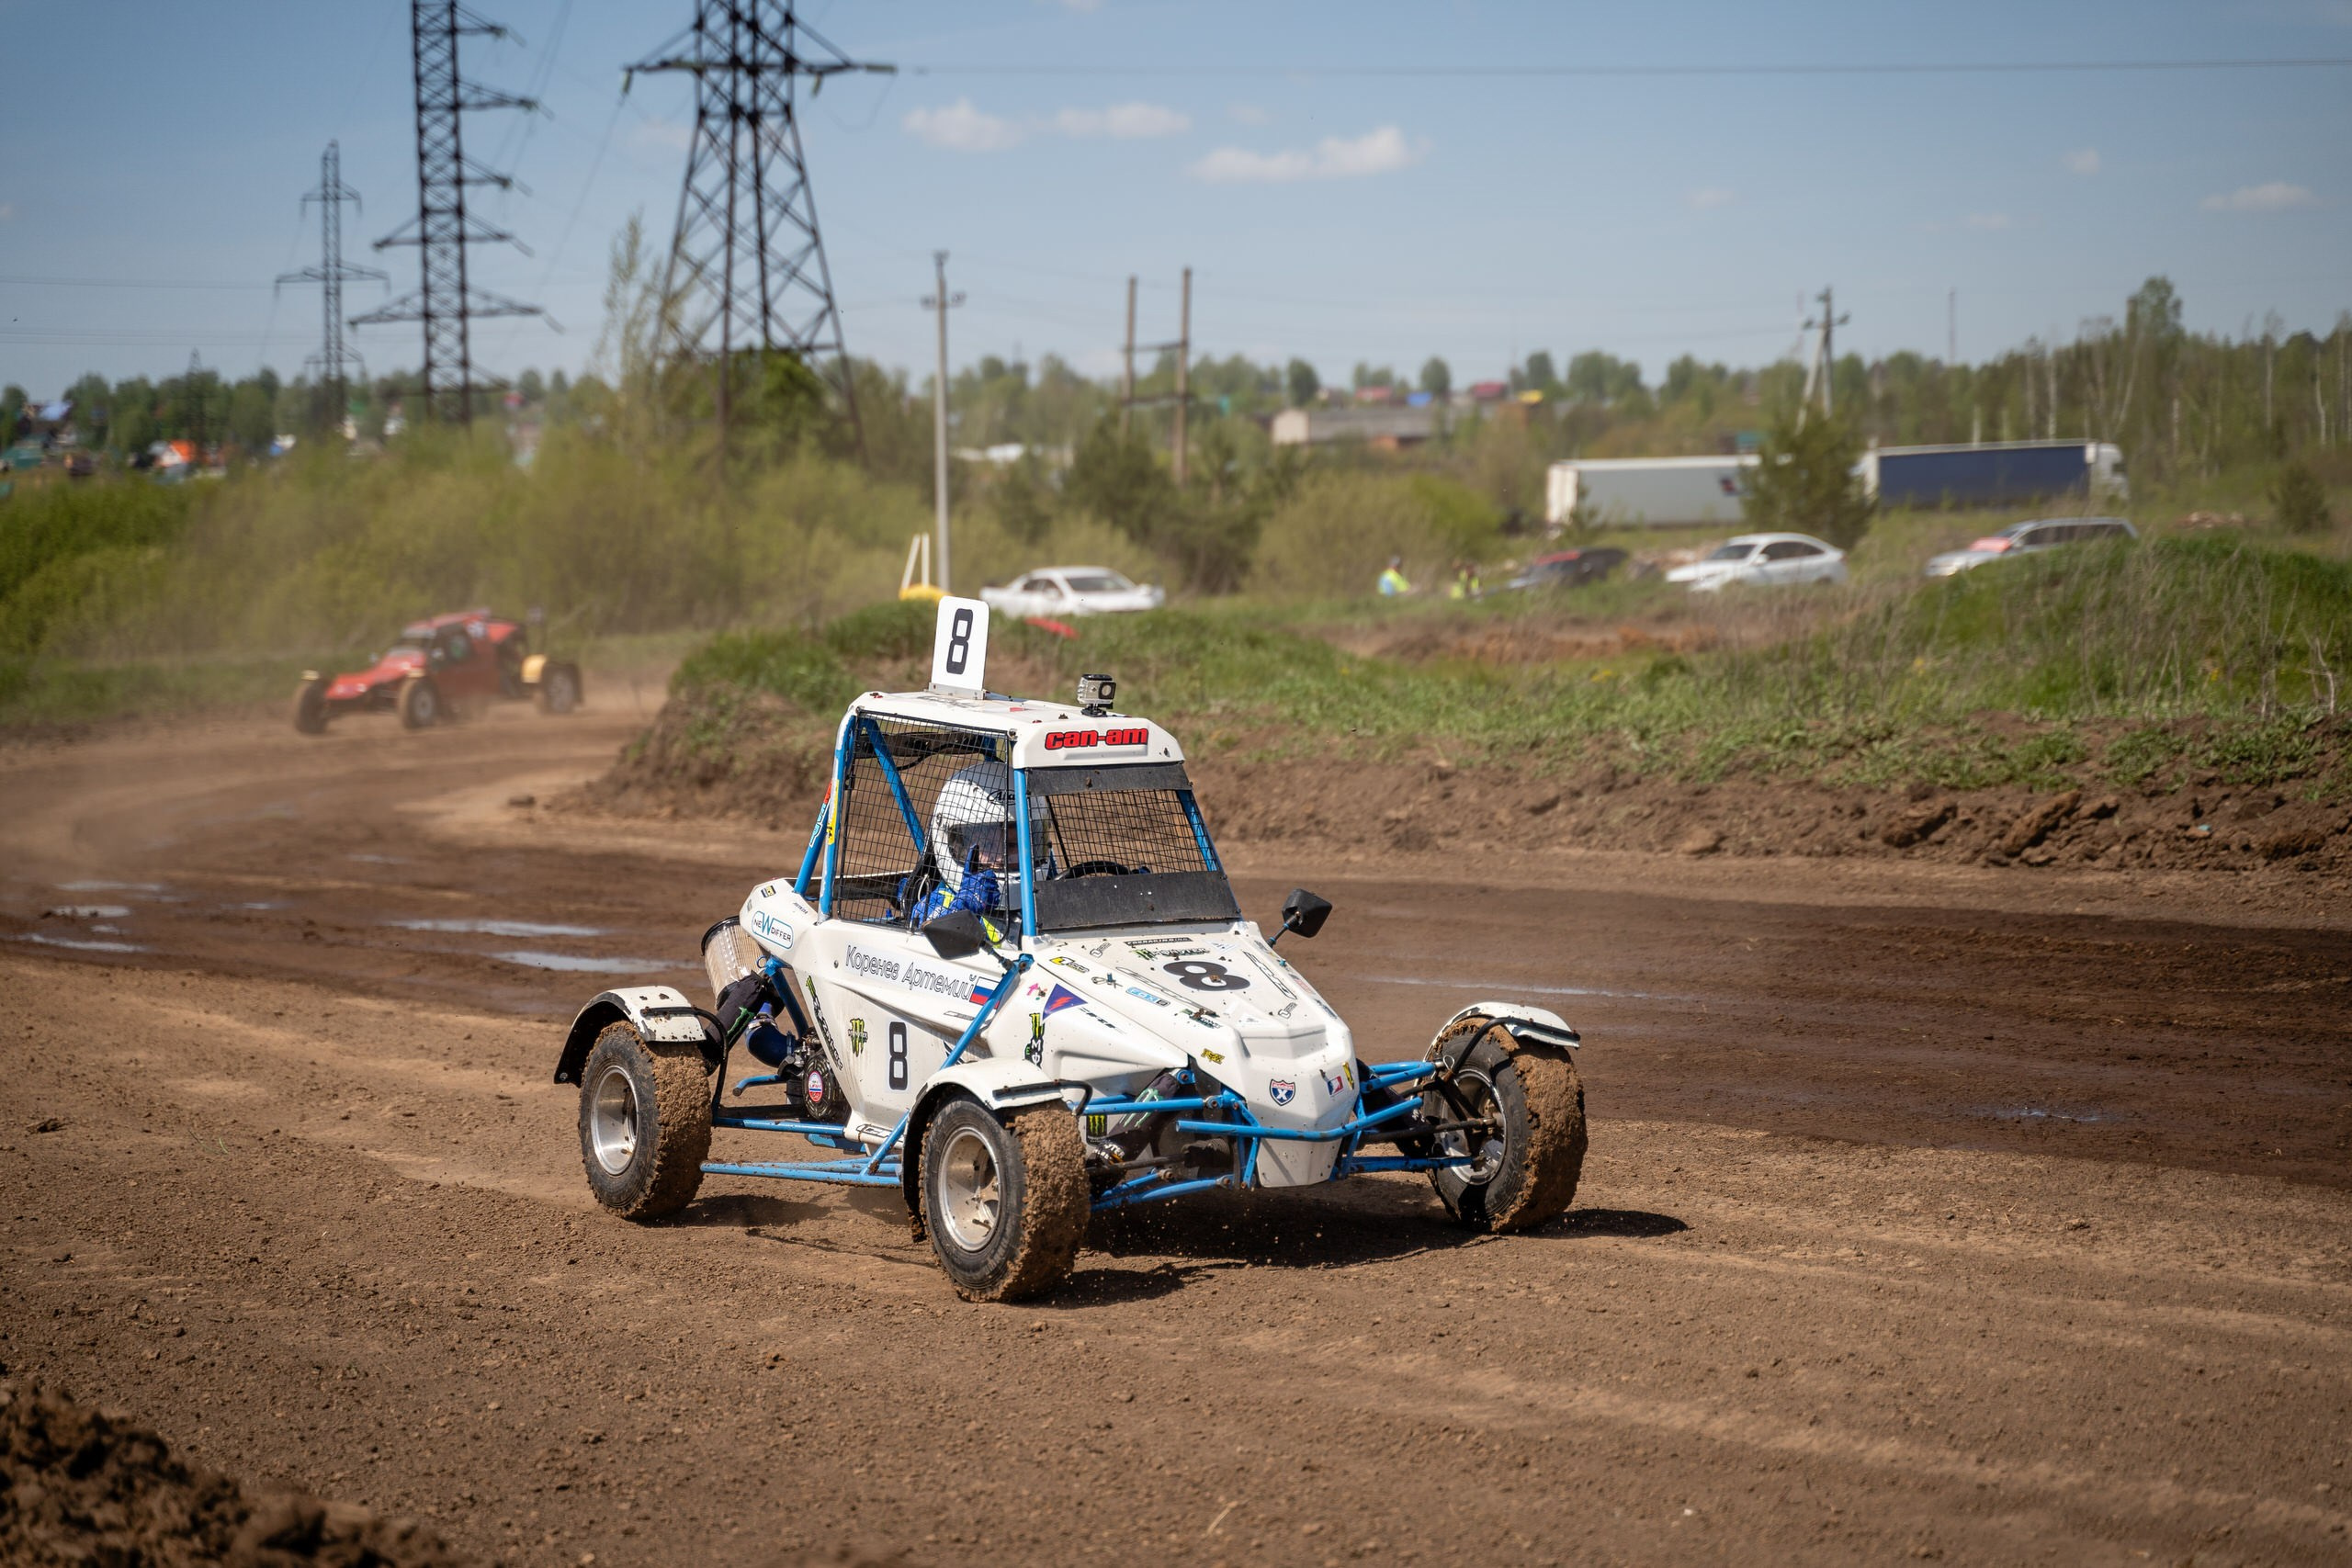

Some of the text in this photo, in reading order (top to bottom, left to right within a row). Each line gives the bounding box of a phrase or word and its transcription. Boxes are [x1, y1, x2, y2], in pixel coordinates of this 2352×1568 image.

[946, 608, 973, 674] 8
[1045, 728, 1148, 750] can-am
[845, 945, 977, 1000] Коренев Артемий
[1163, 961, 1250, 991] 8
[888, 1021, 909, 1090] 8
